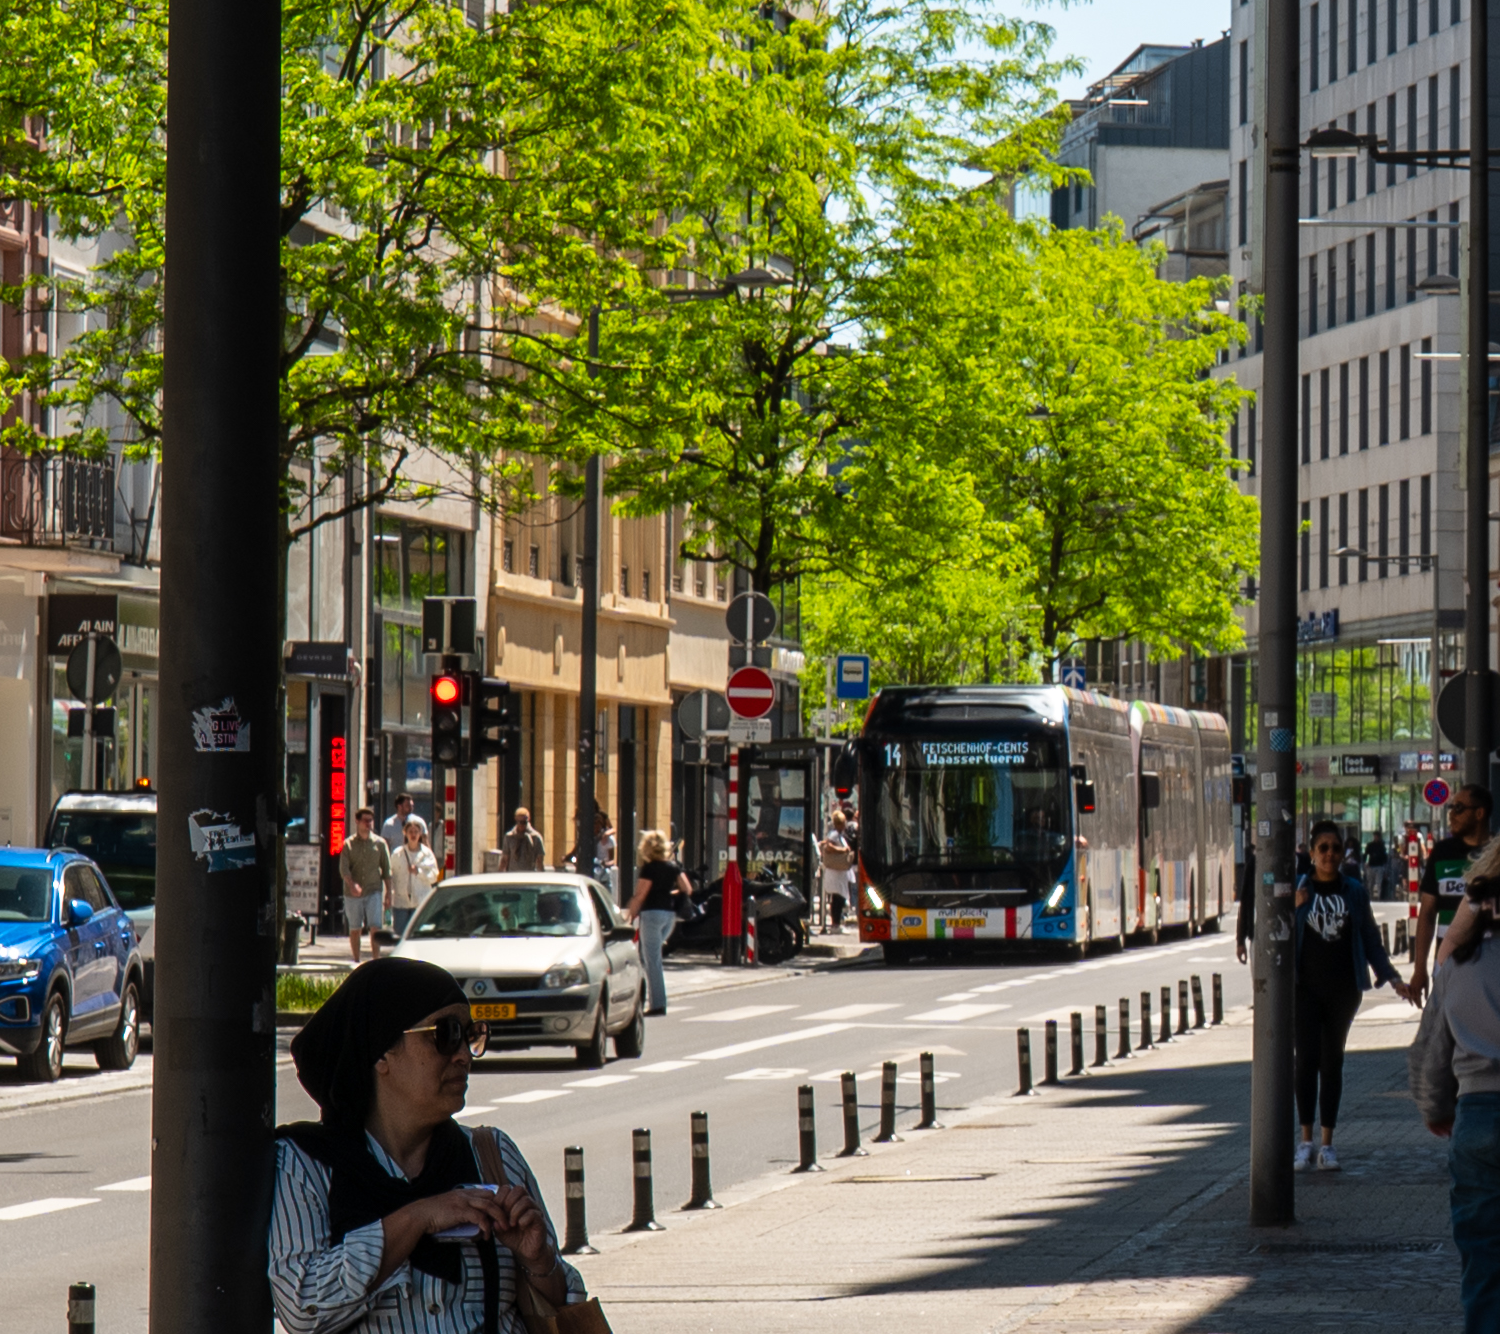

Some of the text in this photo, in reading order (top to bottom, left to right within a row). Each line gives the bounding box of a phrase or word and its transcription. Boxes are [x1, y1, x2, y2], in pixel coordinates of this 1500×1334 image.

[884, 742, 1029, 767] 14 FETSCHENHOF-CENTS
[926, 754, 1025, 765] Waassertuerm
[755, 849, 798, 863] ASAZ.
[1445, 880, 1466, 893] Be
[475, 1004, 510, 1019] 6869
